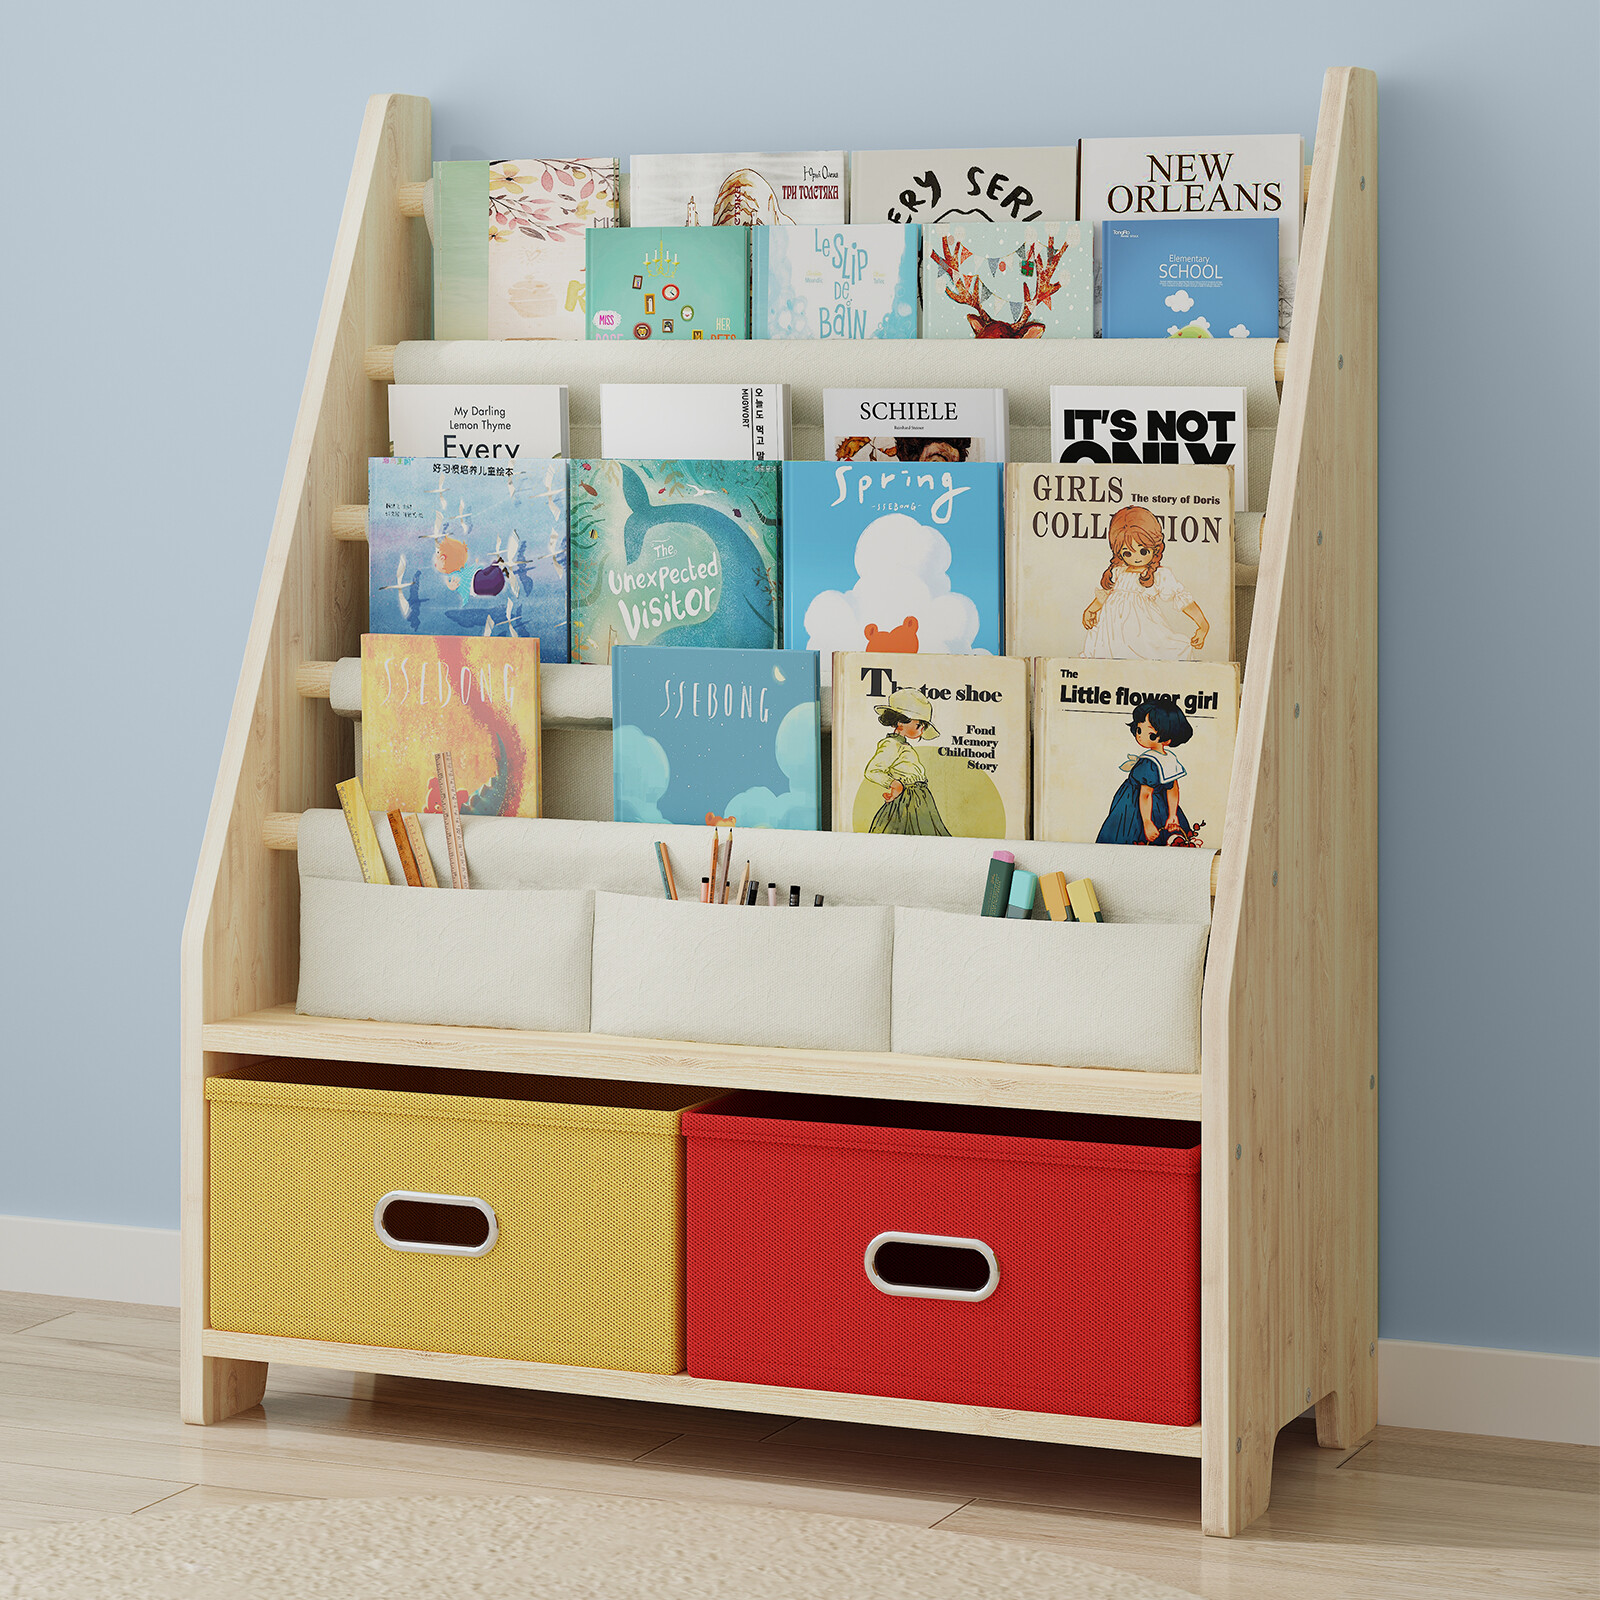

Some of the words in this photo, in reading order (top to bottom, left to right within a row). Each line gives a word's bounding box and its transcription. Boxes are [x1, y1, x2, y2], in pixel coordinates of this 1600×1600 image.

[1147, 153, 1235, 183] NEW
[782, 185, 797, 200] ТРИ
[1107, 182, 1283, 214] ORLEANS
[1169, 254, 1210, 264] Elementary
[1159, 263, 1223, 279] SCHOOL
[599, 315, 615, 326] MISS
[716, 318, 731, 331] HER
[454, 406, 468, 418] My
[472, 405, 506, 418] Darling
[741, 388, 749, 428] MUGWORT
[860, 402, 958, 421] SCHIELE
[449, 420, 478, 430] Lemon
[482, 420, 511, 432] Thyme
[1064, 409, 1137, 441] IT'S
[1147, 410, 1236, 442] NOT
[433, 463, 514, 477] 好习惯培养儿童绘本
[830, 466, 971, 524] Spring
[1033, 474, 1123, 503] GIRLS
[1131, 493, 1149, 503] The
[1152, 495, 1177, 506] story
[1180, 495, 1191, 504] of
[1194, 496, 1220, 505] Doris
[1032, 511, 1222, 543] COLLION
[653, 544, 674, 558] The
[1060, 669, 1078, 679] The
[380, 657, 515, 709] SSEBONG
[861, 667, 905, 698] Th
[920, 684, 951, 700] toe
[956, 684, 1002, 703] shoe
[659, 680, 769, 723] SSEBONG
[1060, 685, 1111, 705] Little
[1185, 691, 1218, 714] girl
[966, 725, 996, 736] Fond
[951, 736, 998, 749] Memory
[938, 747, 996, 759] Childhood
[967, 760, 998, 773] Story
